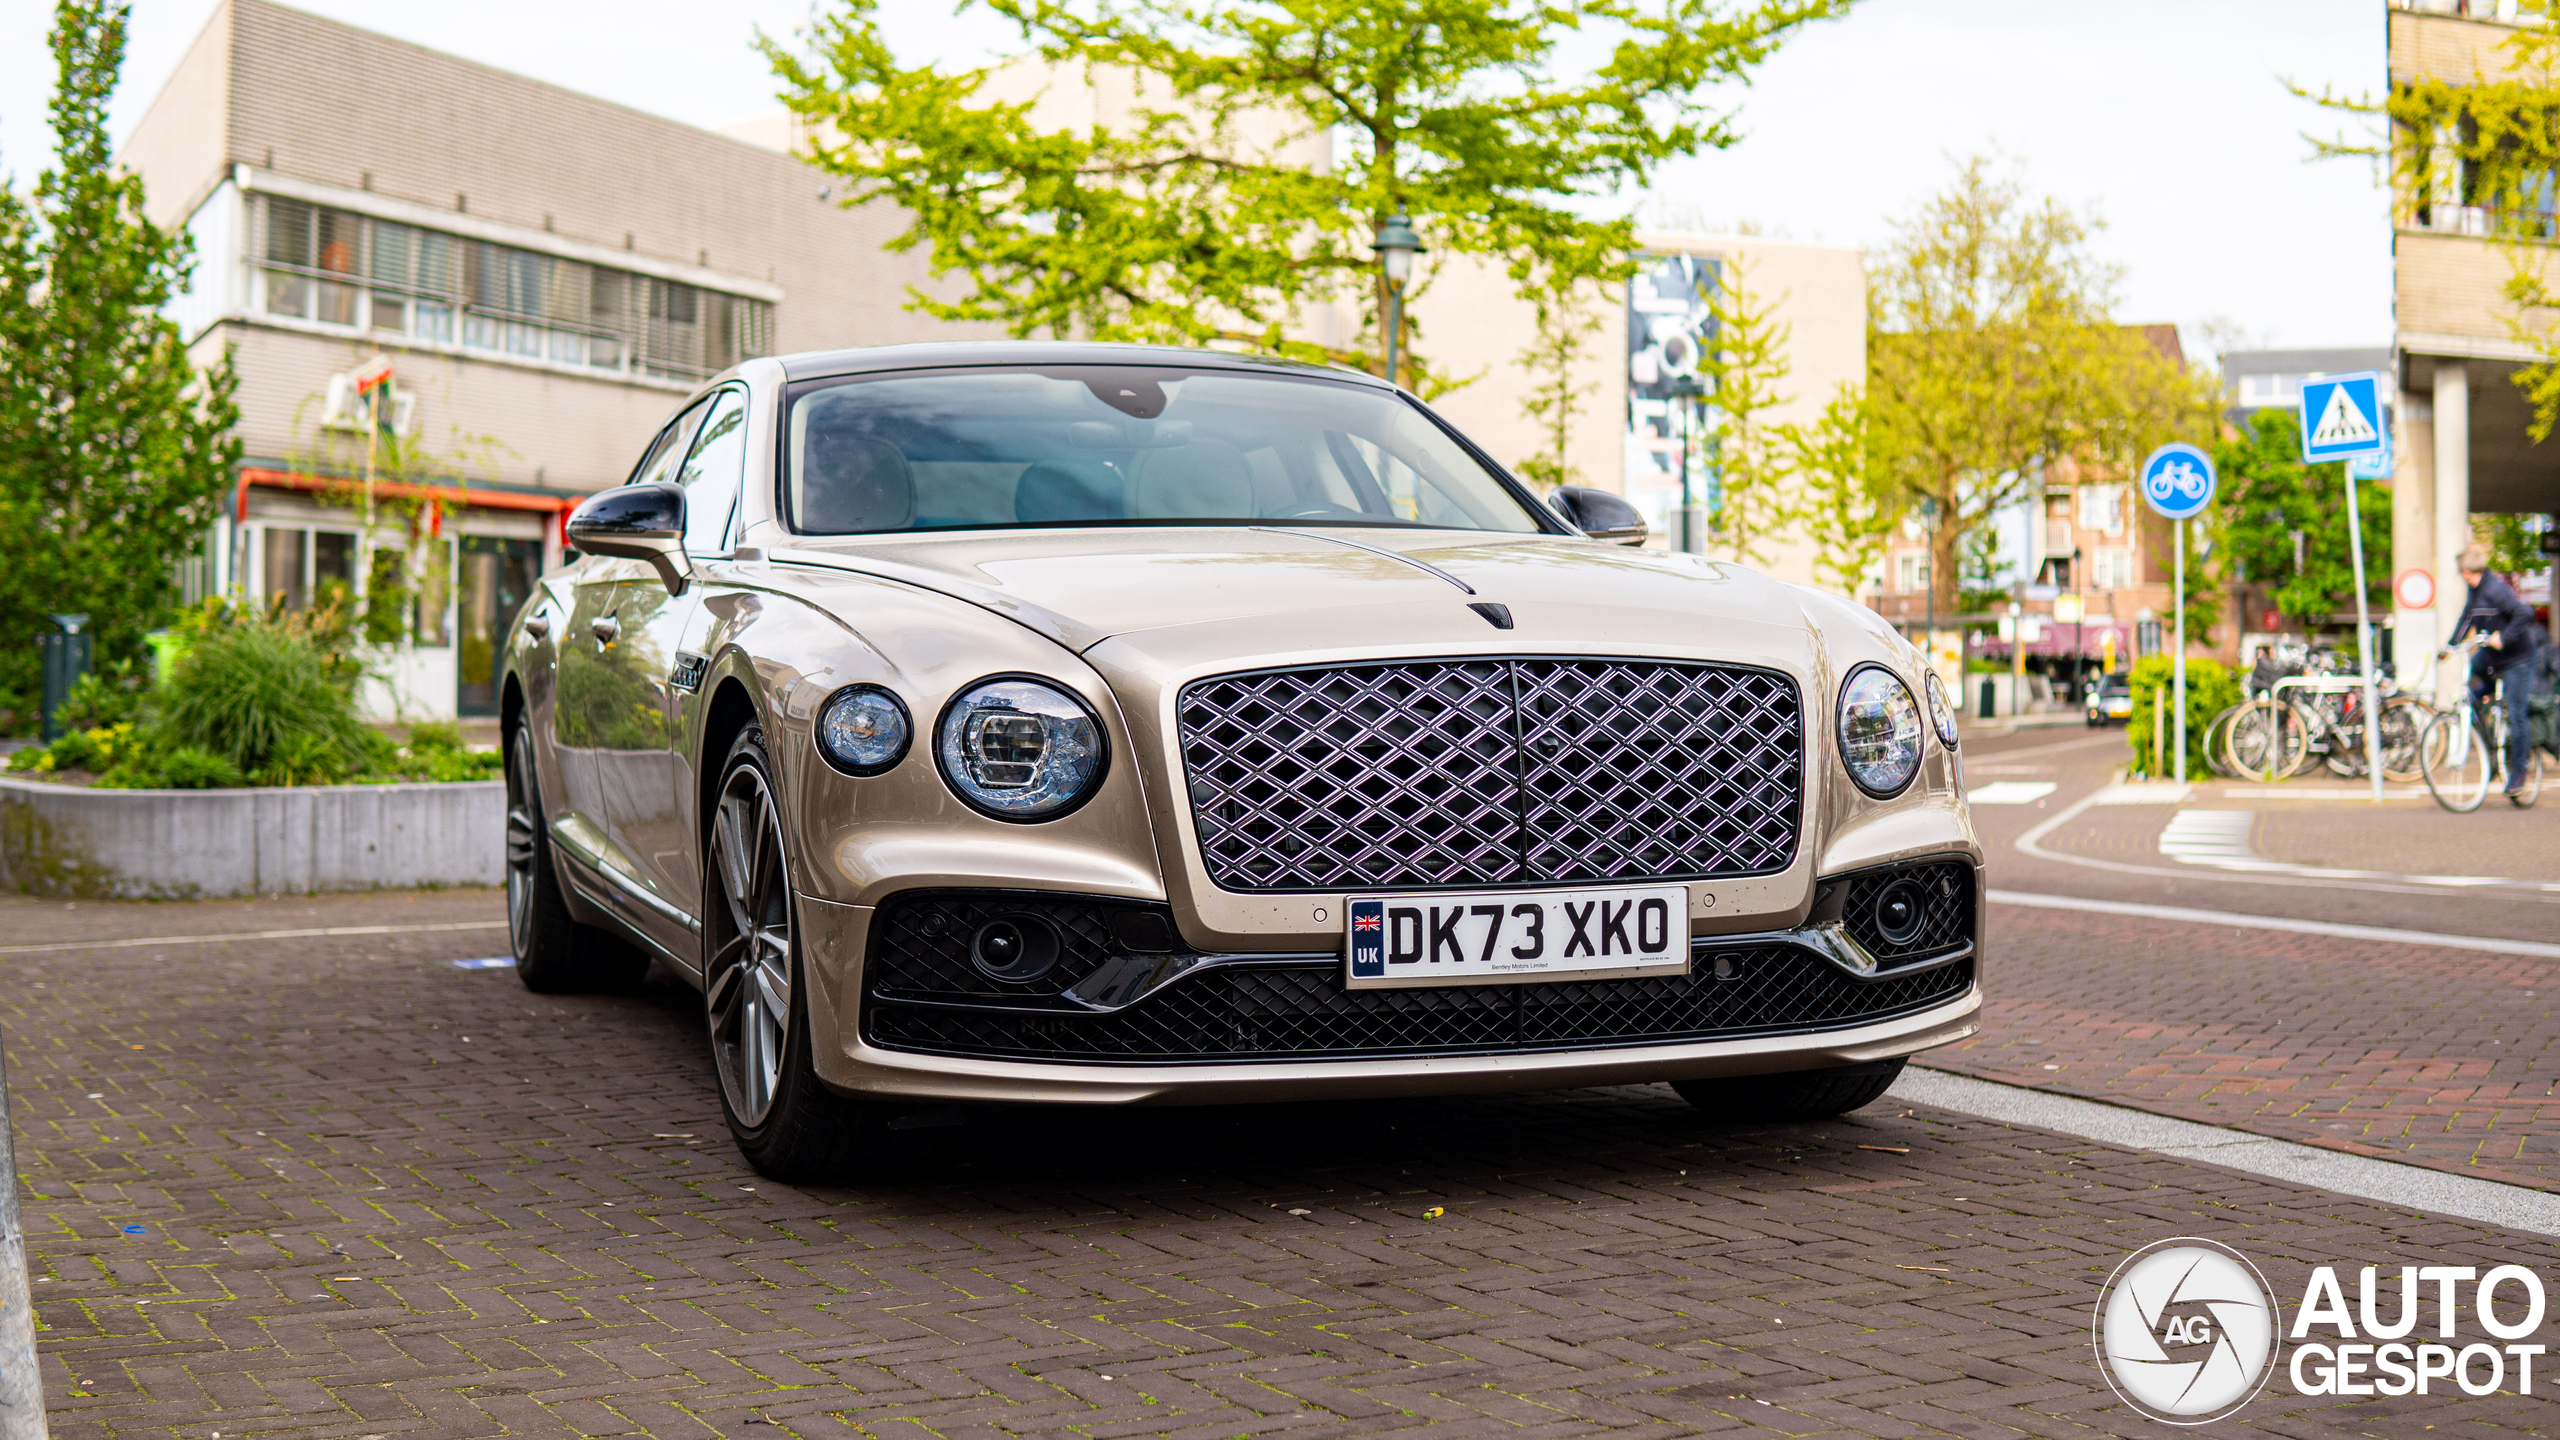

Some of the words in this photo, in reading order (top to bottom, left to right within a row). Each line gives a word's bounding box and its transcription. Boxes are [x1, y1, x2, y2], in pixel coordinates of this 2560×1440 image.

[1388, 904, 1544, 964] DK73
[1564, 898, 1668, 957] XKO
[1357, 947, 1379, 964] UK
